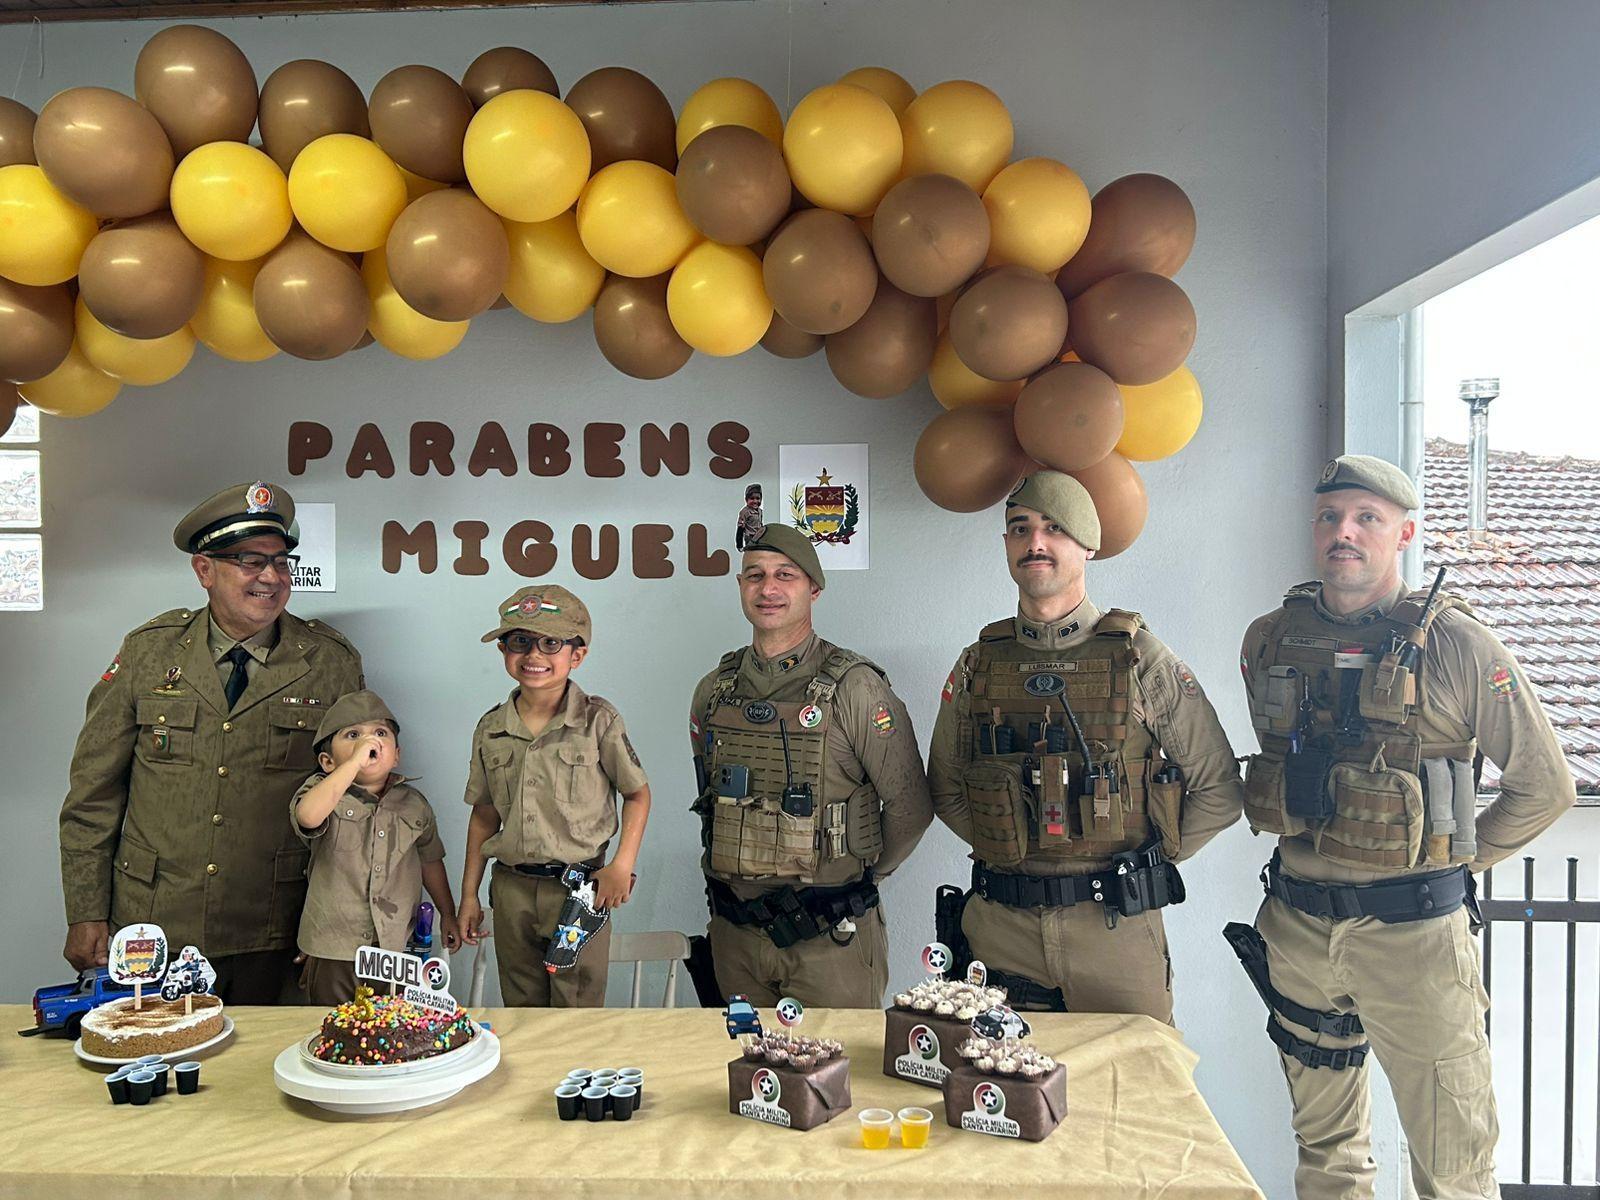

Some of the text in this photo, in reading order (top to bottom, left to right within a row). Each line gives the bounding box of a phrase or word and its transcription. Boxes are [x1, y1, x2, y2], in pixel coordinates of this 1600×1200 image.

[288, 421, 753, 479] PARABENS
[382, 520, 731, 580] MIGUEL
[359, 950, 420, 987] MIGUEL
[962, 1121, 1018, 1136] SANTA CATARINA
[990, 1119, 1018, 1130] MILITAR
